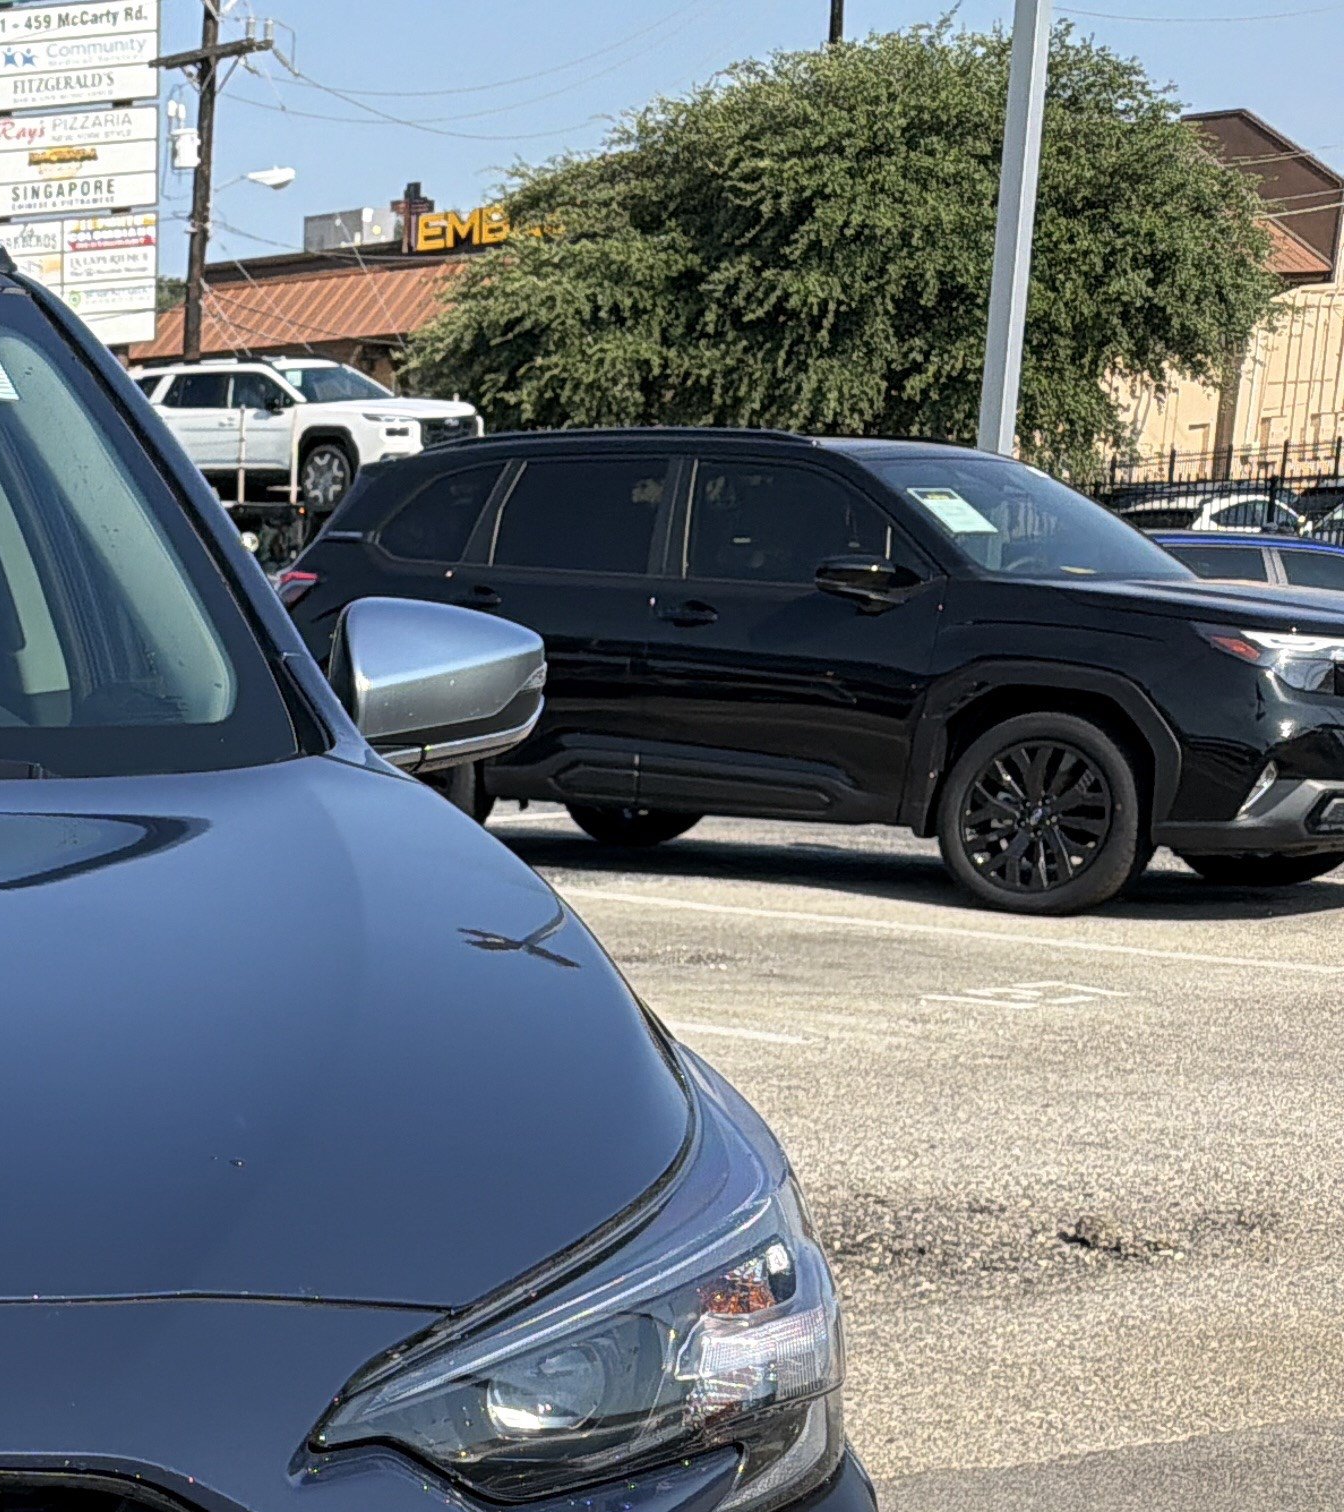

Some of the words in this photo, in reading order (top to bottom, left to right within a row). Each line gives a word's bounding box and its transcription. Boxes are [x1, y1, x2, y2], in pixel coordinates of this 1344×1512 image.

[24, 14, 52, 31] 459
[57, 8, 119, 29] McCarty
[124, 5, 148, 22] Rd.
[46, 38, 148, 59] Community
[13, 72, 115, 95] FITZGERALD'S
[52, 112, 133, 132] PIZZARIA
[12, 178, 116, 202] SINGAPORE
